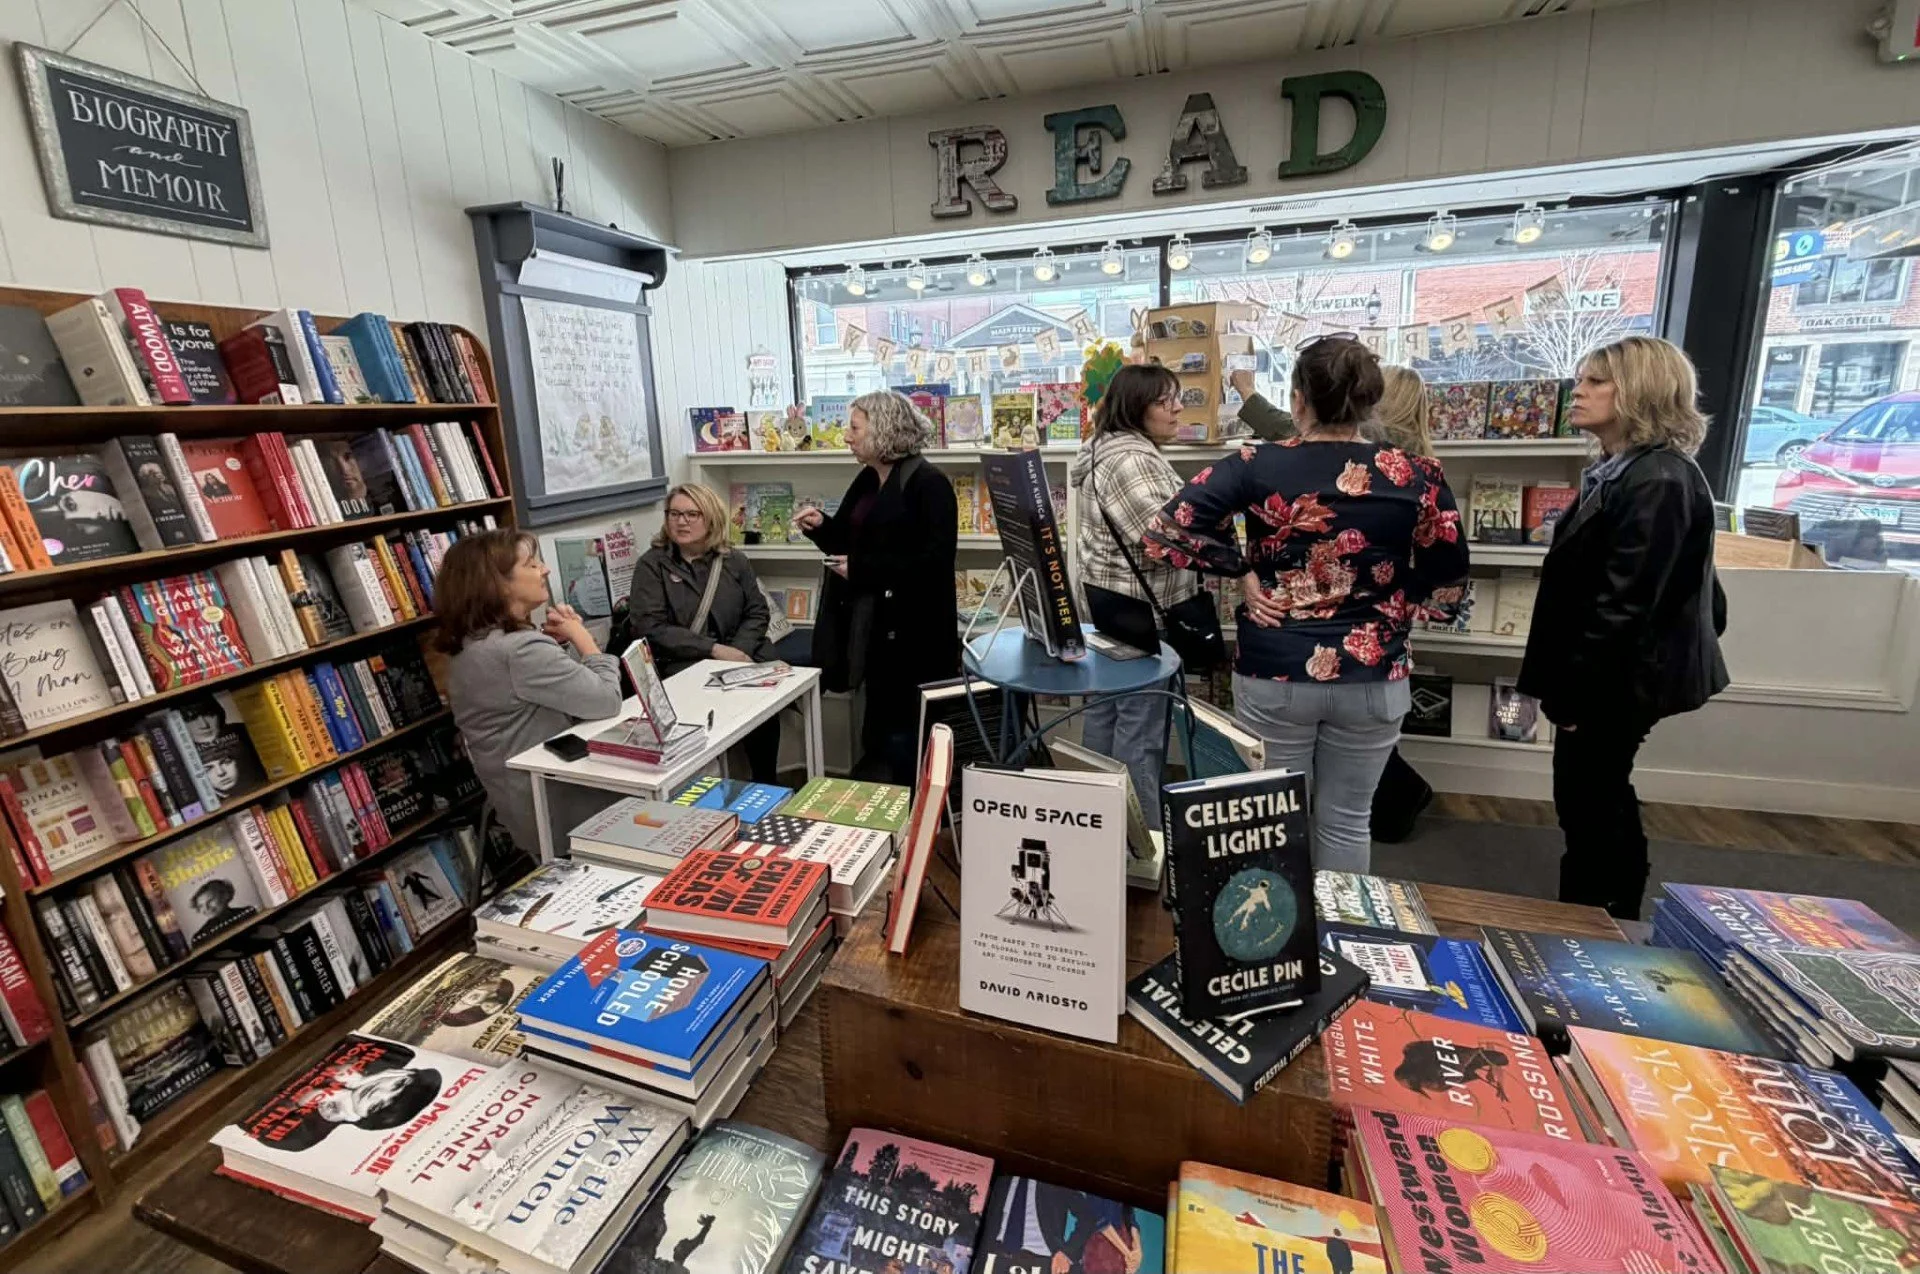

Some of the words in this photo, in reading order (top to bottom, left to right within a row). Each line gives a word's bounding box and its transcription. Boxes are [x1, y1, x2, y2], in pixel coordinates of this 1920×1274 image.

[67, 90, 231, 157] BIOGRAPHY
[112, 145, 203, 168] and
[928, 69, 1387, 217] READ
[97, 159, 229, 213] MEMOIR
[1315, 297, 1368, 313] EWELRY
[1846, 316, 1885, 325] STEEL
[127, 302, 172, 372] ATWOOD
[188, 325, 211, 338] for
[990, 327, 1011, 336] MAIN
[1012, 326, 1042, 334] STREET
[19, 459, 98, 504] Cher
[1025, 459, 1037, 488] MARY
[1033, 489, 1046, 520] KUBICA
[1040, 525, 1055, 555] IT'S
[1472, 509, 1518, 542] KIN
[1047, 561, 1064, 591] NOT
[142, 583, 217, 606] ELIZABETH
[157, 597, 215, 617] GILBERT
[1056, 597, 1072, 626] HER
[3, 647, 69, 677] Being
[197, 645, 240, 665] RIVER
[37, 671, 93, 698] Man
[22, 781, 79, 807] DINARY
[382, 796, 416, 817] OBERT
[671, 776, 722, 807] STAN
[854, 786, 891, 822] RESTLESS
[883, 792, 909, 823] STARRY
[1184, 789, 1301, 830] CELESTIAL
[389, 804, 420, 824] REICH
[973, 798, 1028, 820] OPEN
[1034, 807, 1104, 829] SPACE
[1205, 823, 1288, 860] LIGHTS
[674, 854, 740, 908] IDEAS
[730, 860, 796, 916] CHAIN
[1314, 869, 1341, 922] WORLD
[594, 878, 641, 932] FEATHER
[767, 893, 791, 918] KENDI
[1344, 889, 1366, 918] CAN
[1371, 888, 1396, 929] HOLD
[301, 935, 318, 957] THE
[973, 939, 987, 948] THE
[991, 944, 1019, 954] GLOBAL
[1023, 949, 1042, 959] RACE
[1061, 956, 1096, 968] EXPLORE
[980, 932, 998, 941] FROM
[1002, 937, 1026, 946] EARTH
[309, 956, 335, 994] BEATLES
[1000, 955, 1033, 966] CONQUER
[1037, 961, 1052, 970] THE
[1056, 965, 1086, 976] COSMOS
[1208, 966, 1269, 997] CECILE
[1273, 959, 1304, 983] PIN
[1388, 946, 1415, 974] THIEF
[538, 980, 565, 1004] BLOCK
[596, 943, 690, 1027] SCHOOLED
[644, 965, 702, 1014] HOME
[980, 979, 1021, 998] DAVID
[1026, 991, 1089, 1012] ARIOSTO
[1562, 938, 1640, 1029] FAR-FLUNG
[1610, 965, 1649, 1003] LIFE
[338, 1041, 377, 1069] You
[1254, 1056, 1288, 1092] CELESTIAL
[1289, 1034, 1312, 1061] LIGHTS
[1353, 1019, 1386, 1085] WHITE
[442, 1067, 488, 1098] Liza
[1333, 1059, 1353, 1092] IAN
[1432, 1036, 1475, 1107] RIVER
[1505, 1032, 1572, 1140] ROSSING
[1633, 1045, 1740, 1167] Shock
[366, 1102, 451, 1176] Minnelli
[410, 1071, 538, 1185] O'DONNELL
[456, 1092, 541, 1172] NORAH
[603, 1124, 655, 1168] We
[507, 1105, 633, 1224] Women
[728, 1136, 765, 1160] STACEY
[555, 1173, 608, 1226] the
[1371, 1110, 1456, 1274] Westward
[1416, 1134, 1485, 1264] Women
[845, 1186, 891, 1215] THIS
[895, 1204, 960, 1235] STORY
[852, 1226, 931, 1267] MIGHT
[1252, 1242, 1306, 1274] THE
